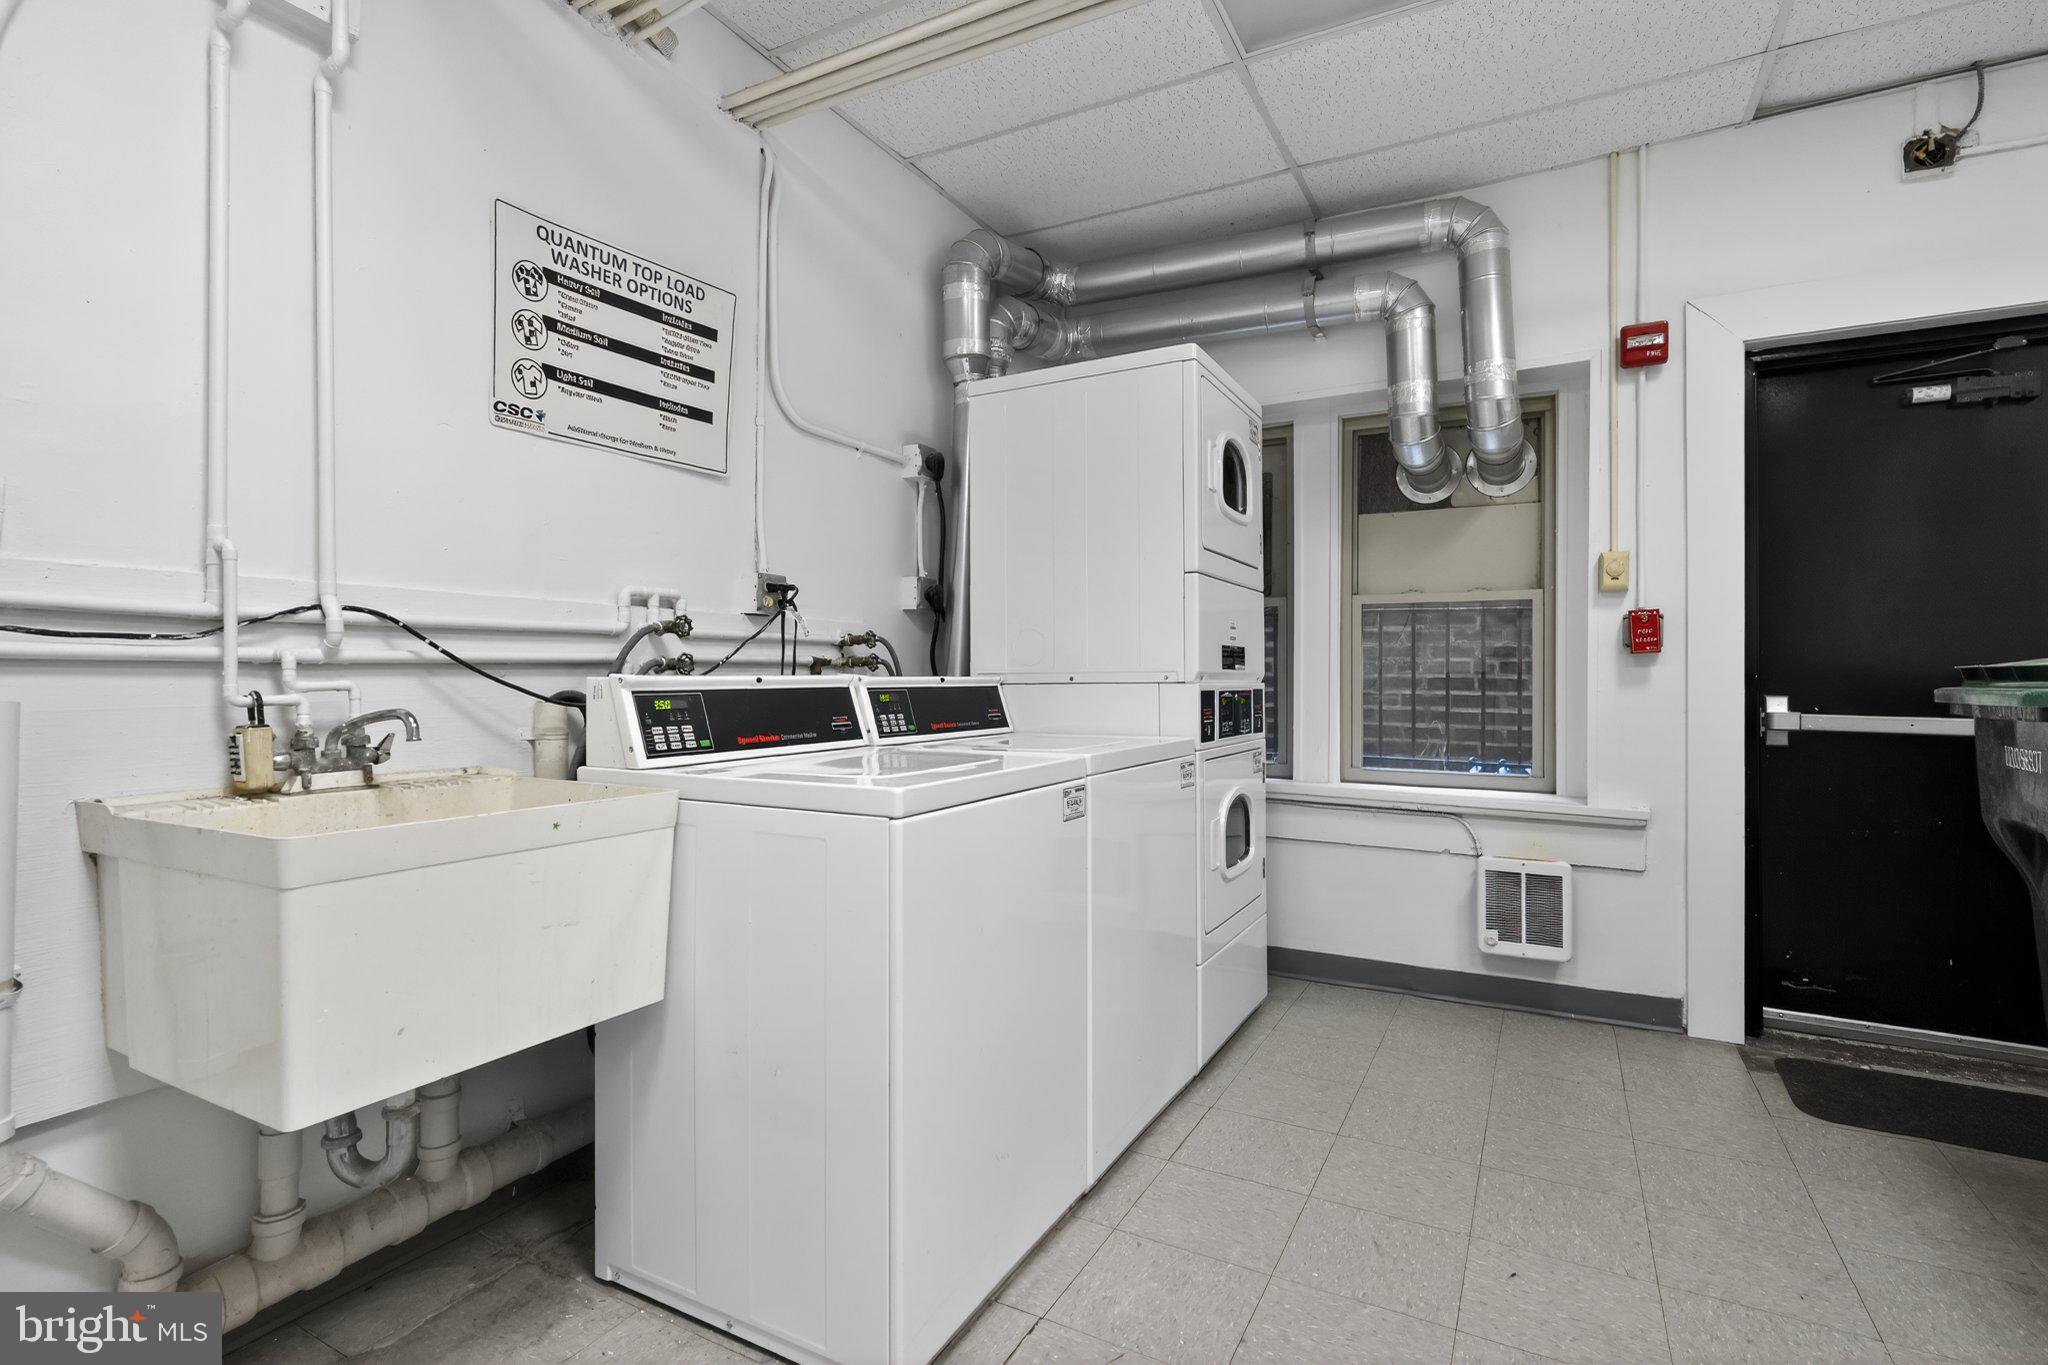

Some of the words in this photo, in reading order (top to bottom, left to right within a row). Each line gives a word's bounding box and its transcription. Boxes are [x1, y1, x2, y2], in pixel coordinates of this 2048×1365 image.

[536, 225, 627, 273] QUANTUM
[632, 261, 663, 285] TOP
[667, 276, 706, 301] LOAD
[551, 248, 622, 289] WASHER
[627, 279, 693, 314] OPTIONS
[493, 400, 533, 419] CSC
